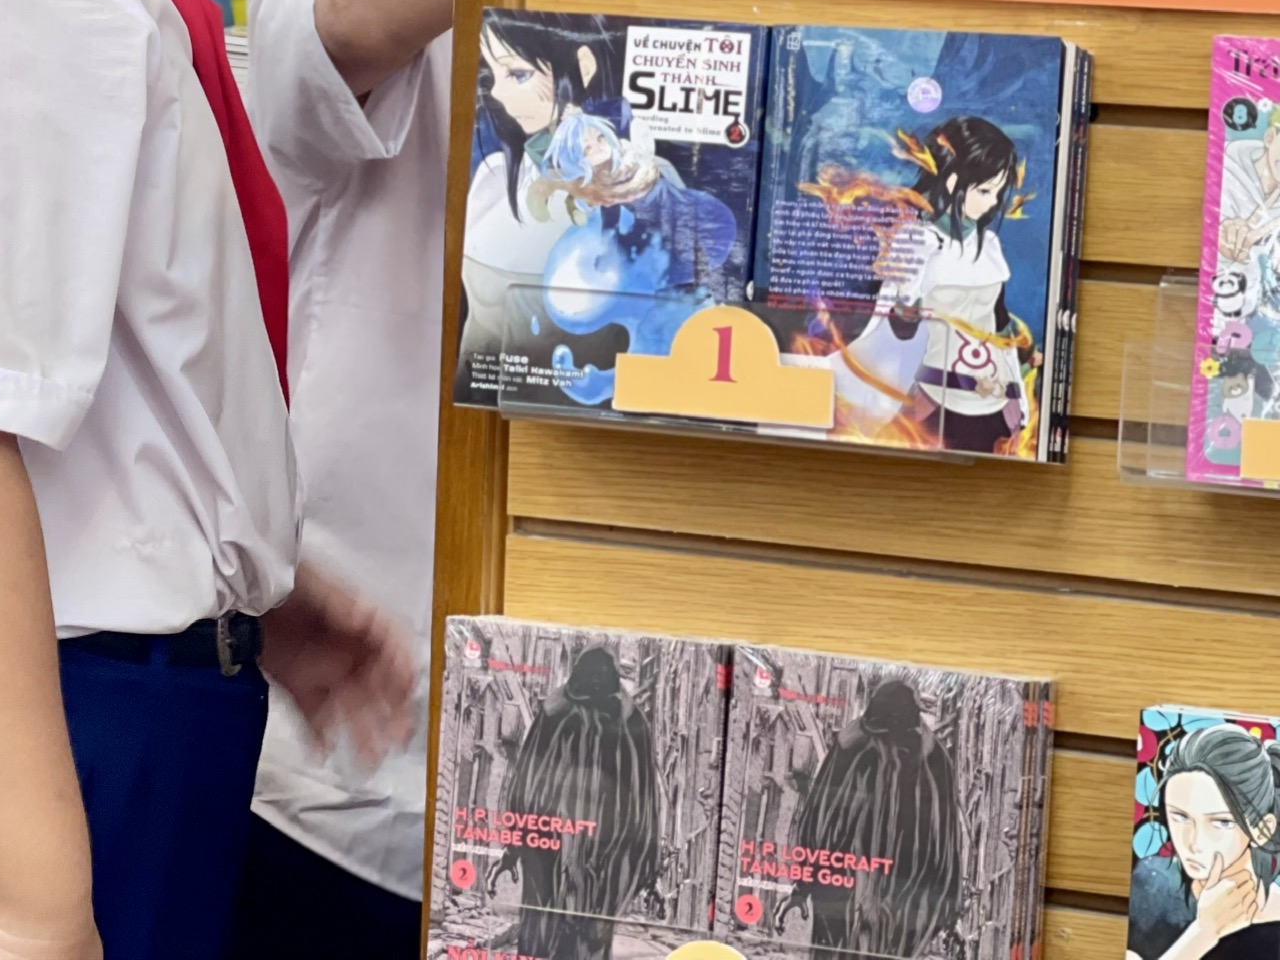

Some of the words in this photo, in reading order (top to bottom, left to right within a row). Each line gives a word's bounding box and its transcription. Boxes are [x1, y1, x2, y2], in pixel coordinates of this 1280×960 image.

[652, 39, 702, 54] CHUYỆN
[705, 35, 743, 55] TÔI
[702, 58, 742, 73] SINH
[660, 72, 717, 87] THÀNH
[628, 71, 743, 117] SLIME
[1232, 103, 1249, 126] 8
[730, 125, 742, 141] 2
[500, 353, 529, 364] Fuse
[708, 326, 738, 384] 1
[503, 364, 528, 373] Taiki
[531, 366, 584, 378] Kawakami
[526, 375, 550, 385] Mitz
[552, 378, 572, 387] Vah
[493, 812, 596, 837] LOVECRAFT
[454, 824, 523, 846] TANABE
[526, 835, 561, 851] Gou
[781, 845, 893, 875] LOVECRAFT
[741, 856, 813, 882] TANABE
[818, 869, 855, 888] Gou
